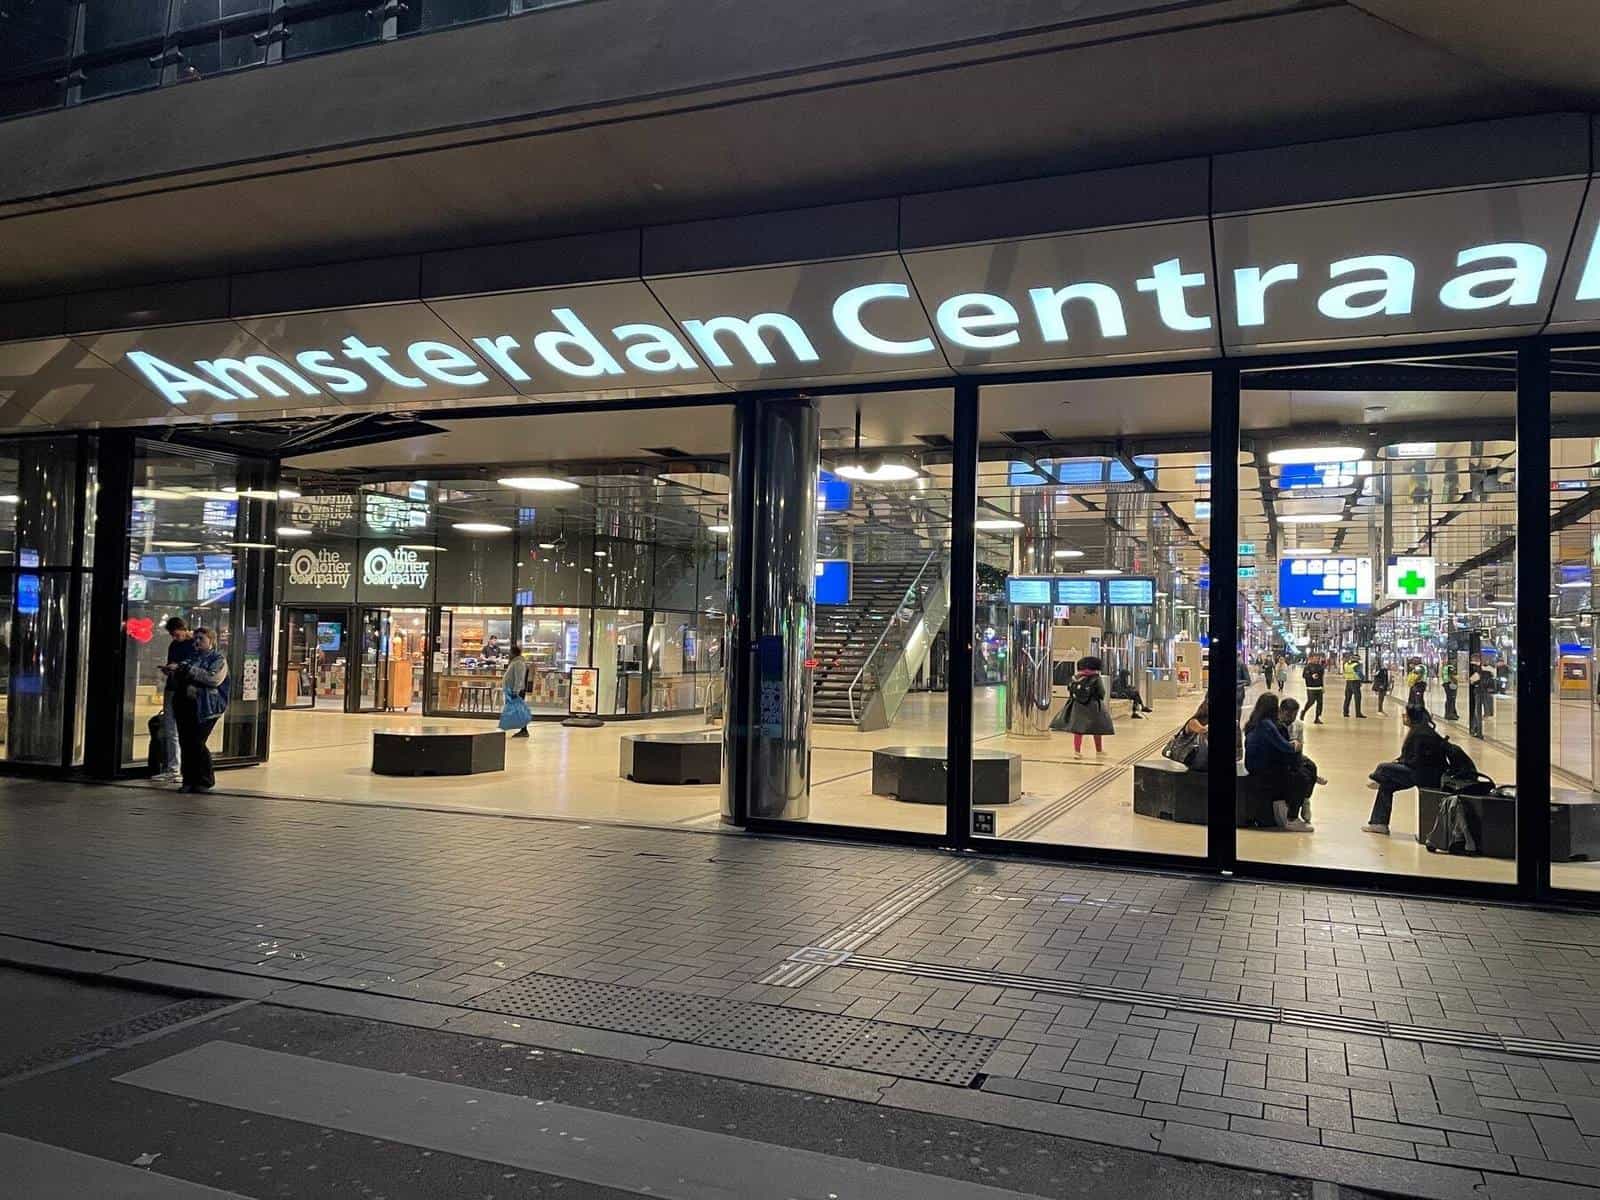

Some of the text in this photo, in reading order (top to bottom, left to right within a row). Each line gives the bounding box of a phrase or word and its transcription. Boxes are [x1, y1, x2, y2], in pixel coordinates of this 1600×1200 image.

[126, 308, 820, 405] Amsterdam
[318, 549, 340, 563] the
[394, 548, 417, 563] the
[289, 573, 351, 589] company
[363, 573, 429, 589] company
[1300, 611, 1321, 621] WC
